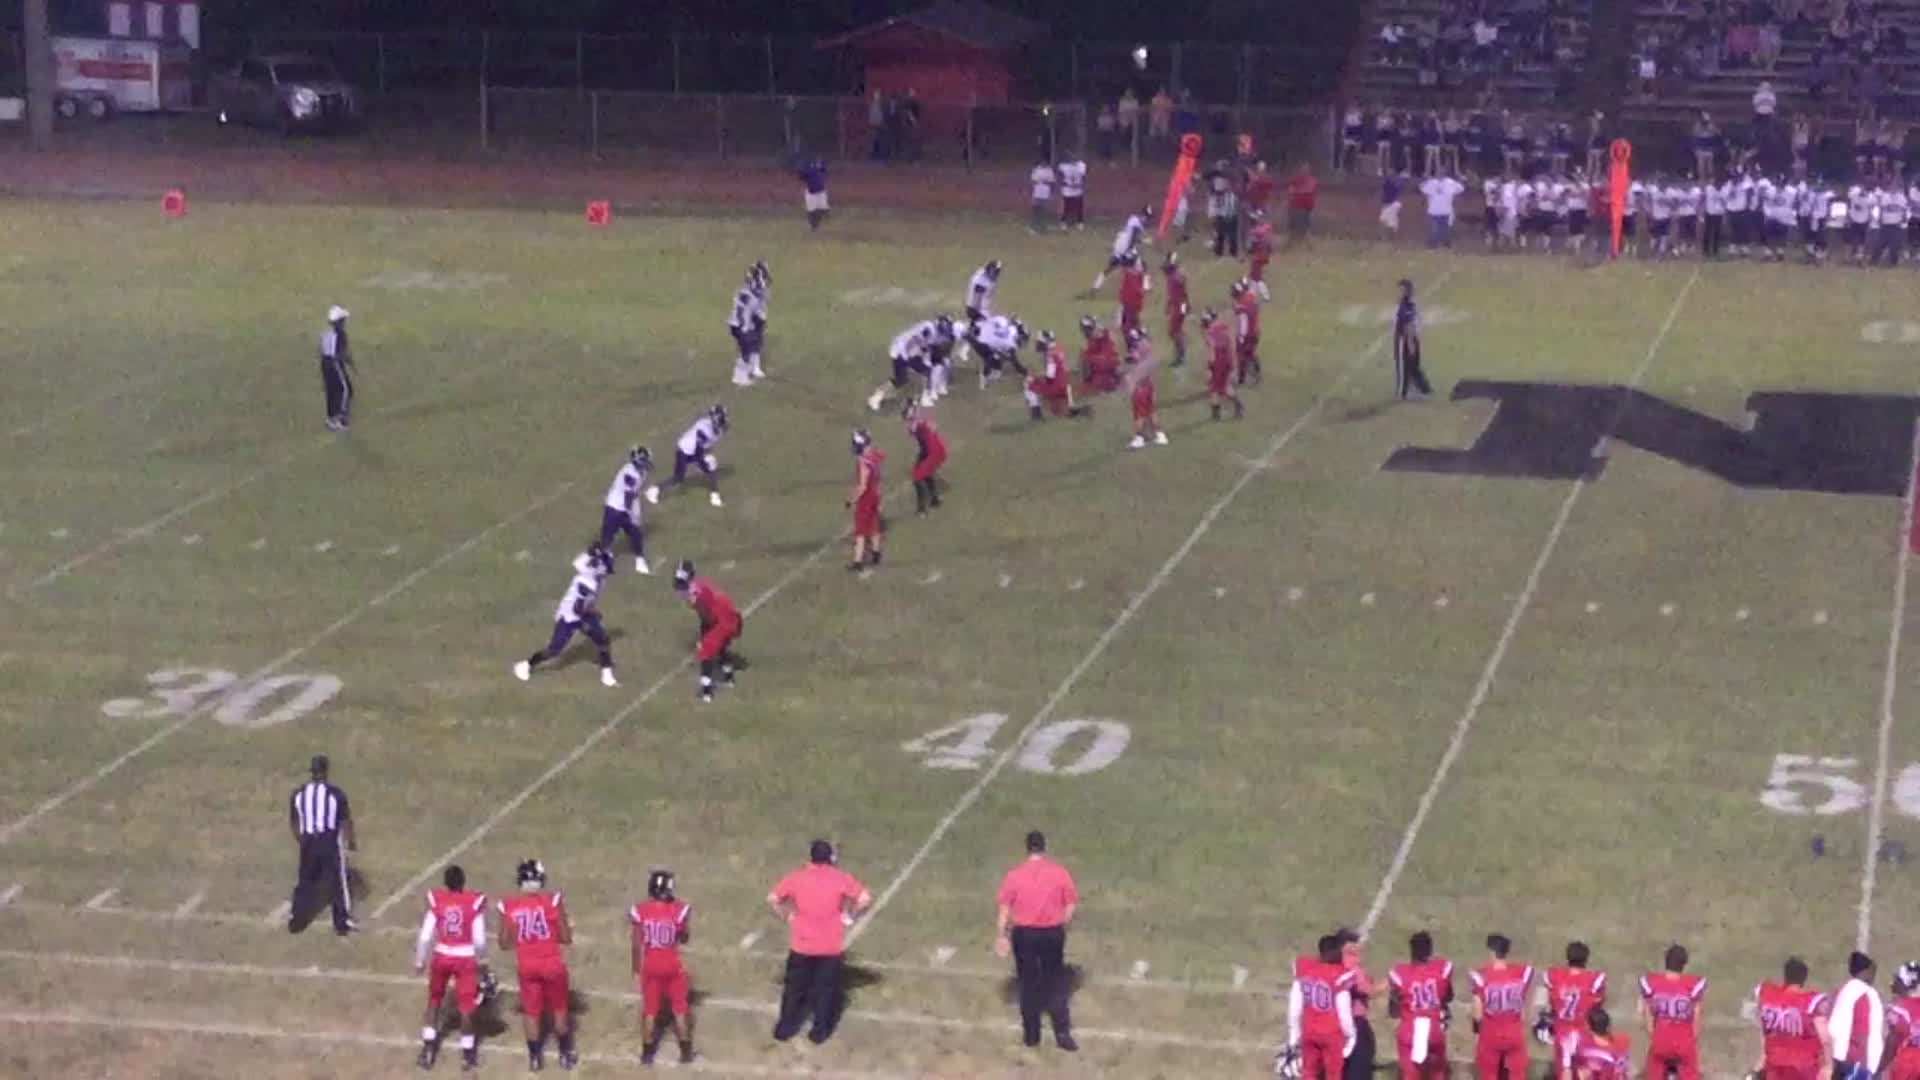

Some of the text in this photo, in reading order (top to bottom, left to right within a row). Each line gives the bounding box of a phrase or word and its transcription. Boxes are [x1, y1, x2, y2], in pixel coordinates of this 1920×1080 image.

[101, 668, 343, 727] 30
[900, 712, 1131, 775] 40
[1760, 753, 1920, 819] 5
[442, 905, 465, 937] 2
[511, 908, 551, 943] 74
[1409, 977, 1439, 1011] 11
